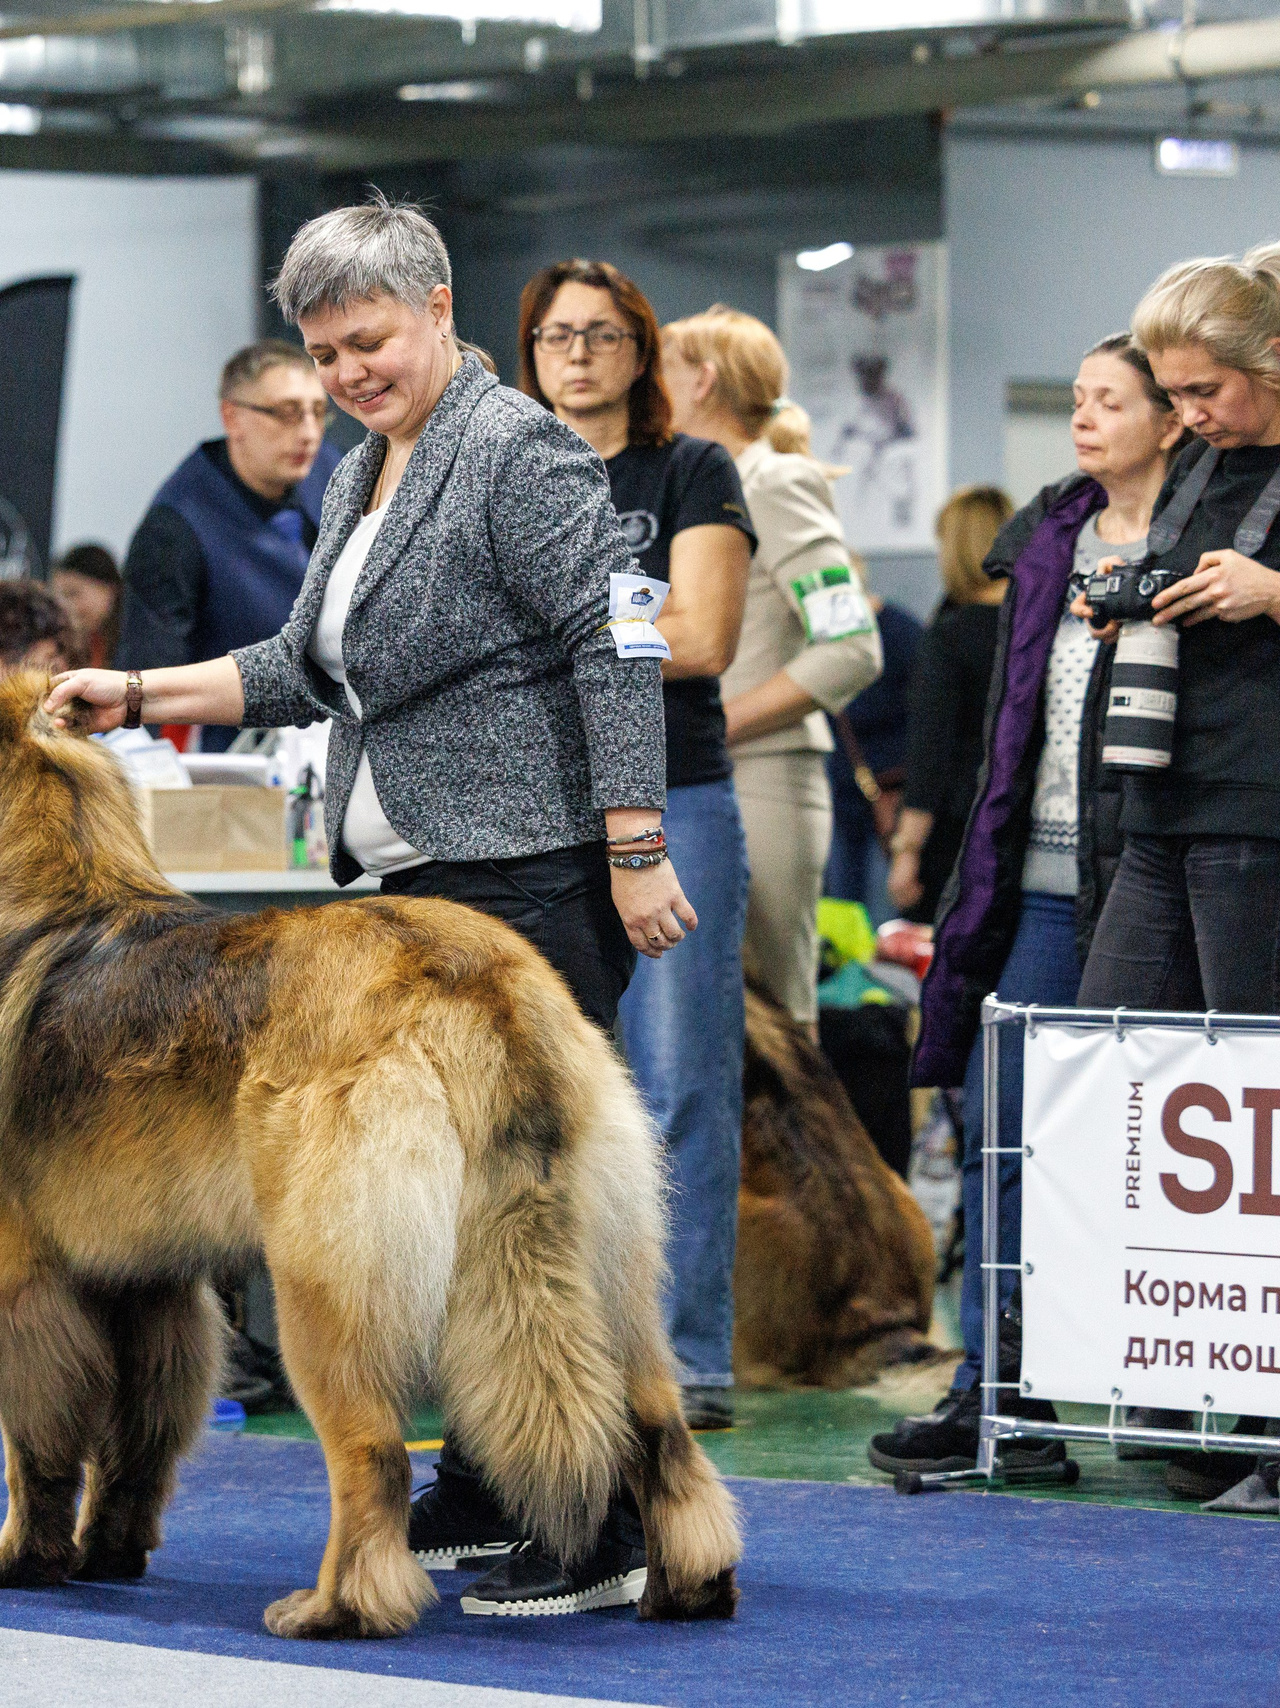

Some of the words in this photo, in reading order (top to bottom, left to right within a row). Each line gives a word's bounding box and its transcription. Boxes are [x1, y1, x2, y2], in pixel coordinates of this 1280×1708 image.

[1125, 1081, 1144, 1209] PREMIUM
[1124, 1269, 1247, 1317] Корма
[1123, 1336, 1194, 1370] для
[1208, 1342, 1280, 1374] кош
